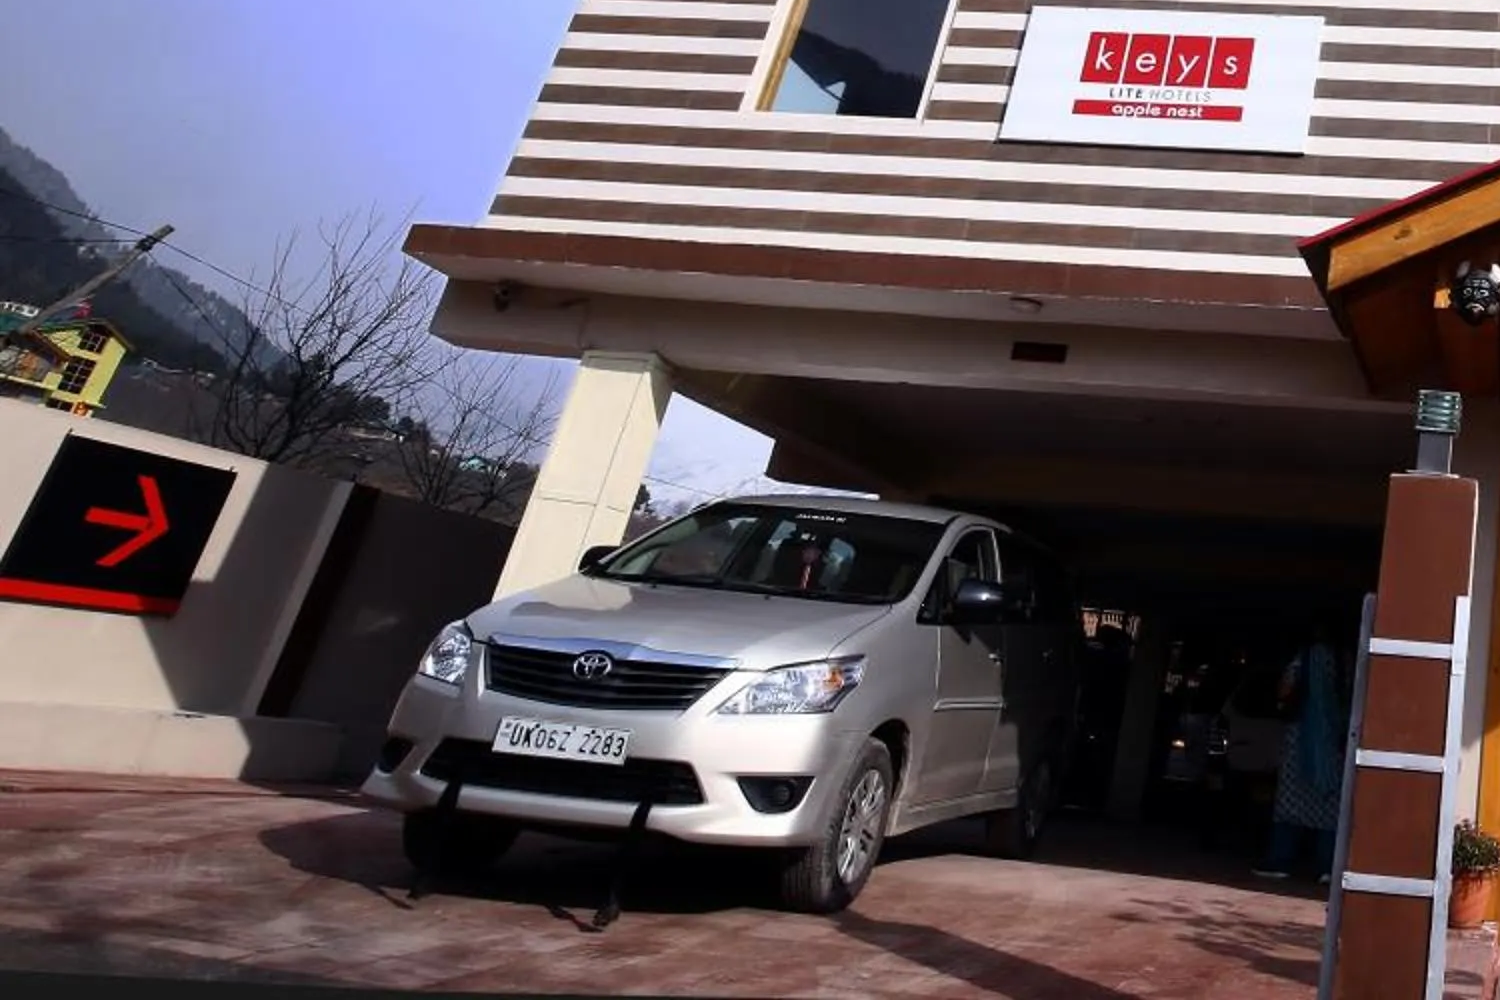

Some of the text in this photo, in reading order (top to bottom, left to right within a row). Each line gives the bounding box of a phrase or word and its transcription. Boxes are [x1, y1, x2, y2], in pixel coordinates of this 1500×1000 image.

[1095, 38, 1238, 83] keys
[1109, 87, 1211, 102] LITE HOTELS
[1111, 103, 1203, 118] apple nest
